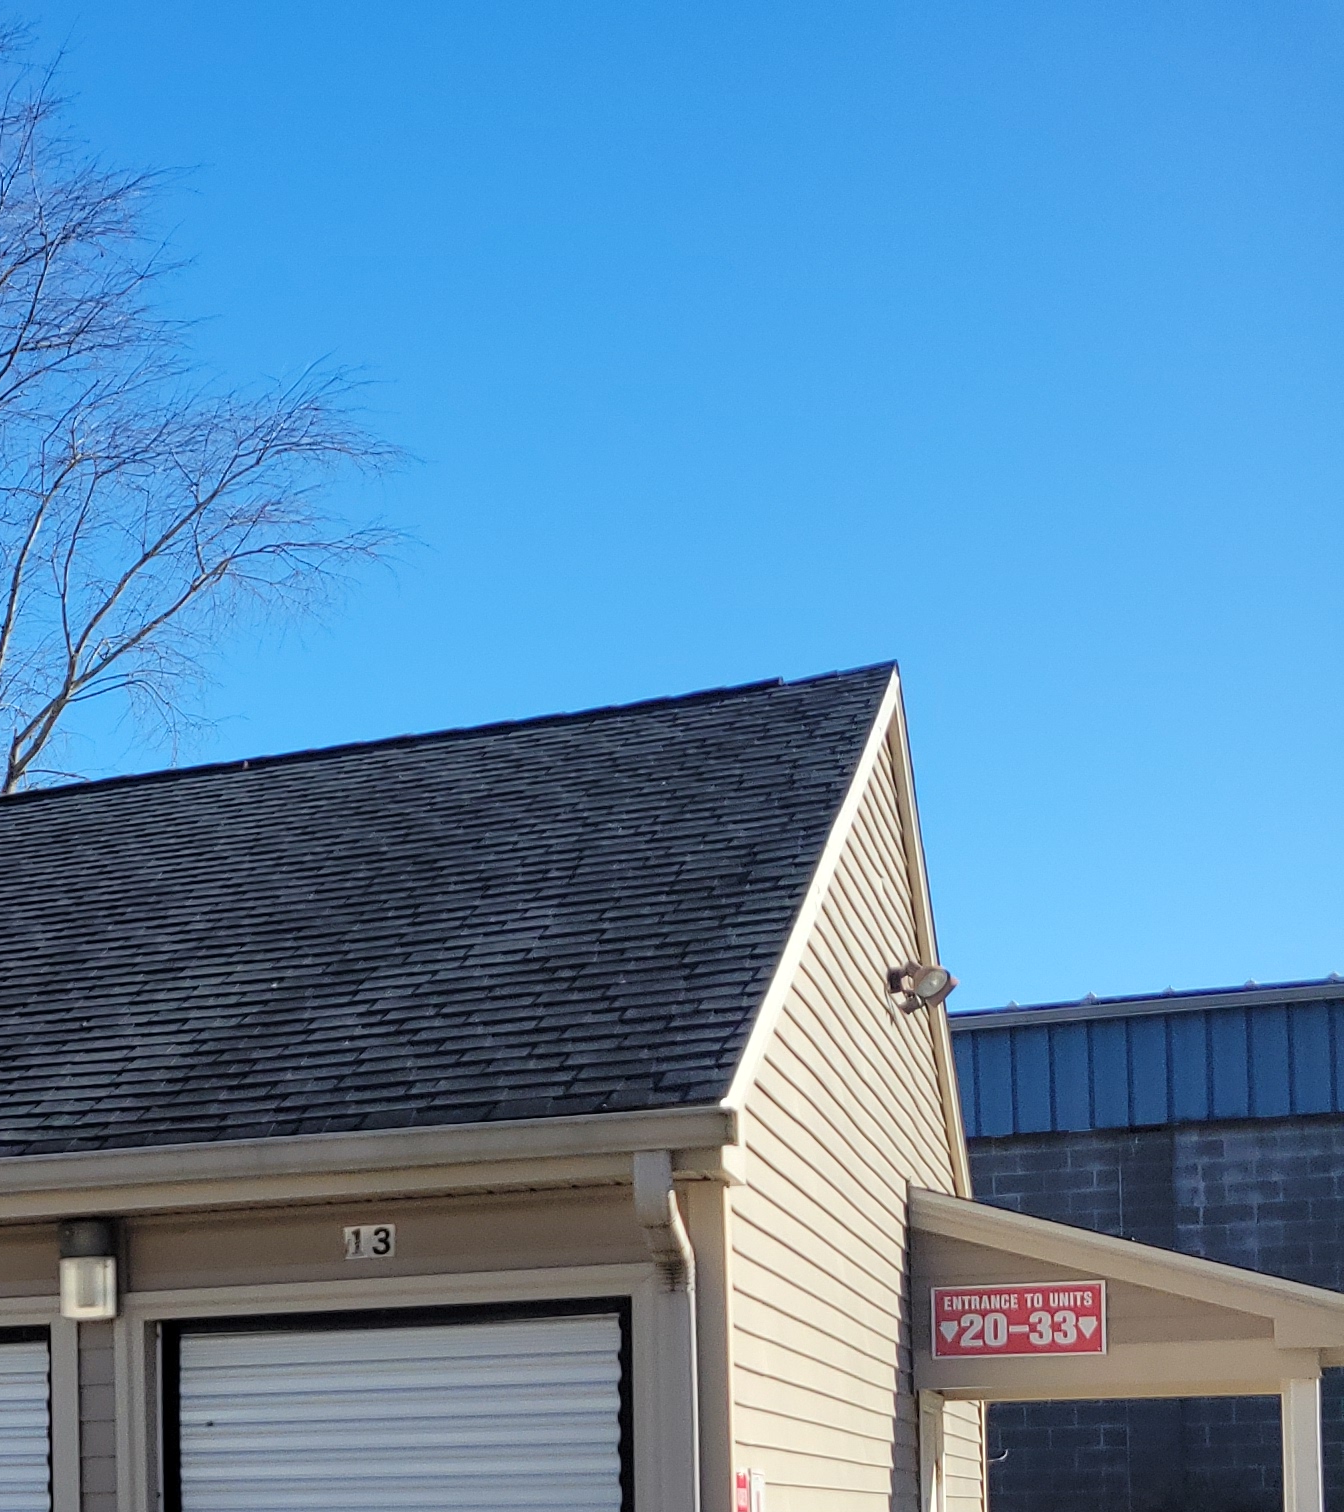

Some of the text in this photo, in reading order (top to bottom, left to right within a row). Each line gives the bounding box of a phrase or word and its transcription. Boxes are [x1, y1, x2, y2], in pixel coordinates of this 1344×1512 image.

[351, 1227, 390, 1256] 13
[943, 1291, 1093, 1311] ENTRANCE TO UNITS
[959, 1310, 1078, 1347] 20-33
